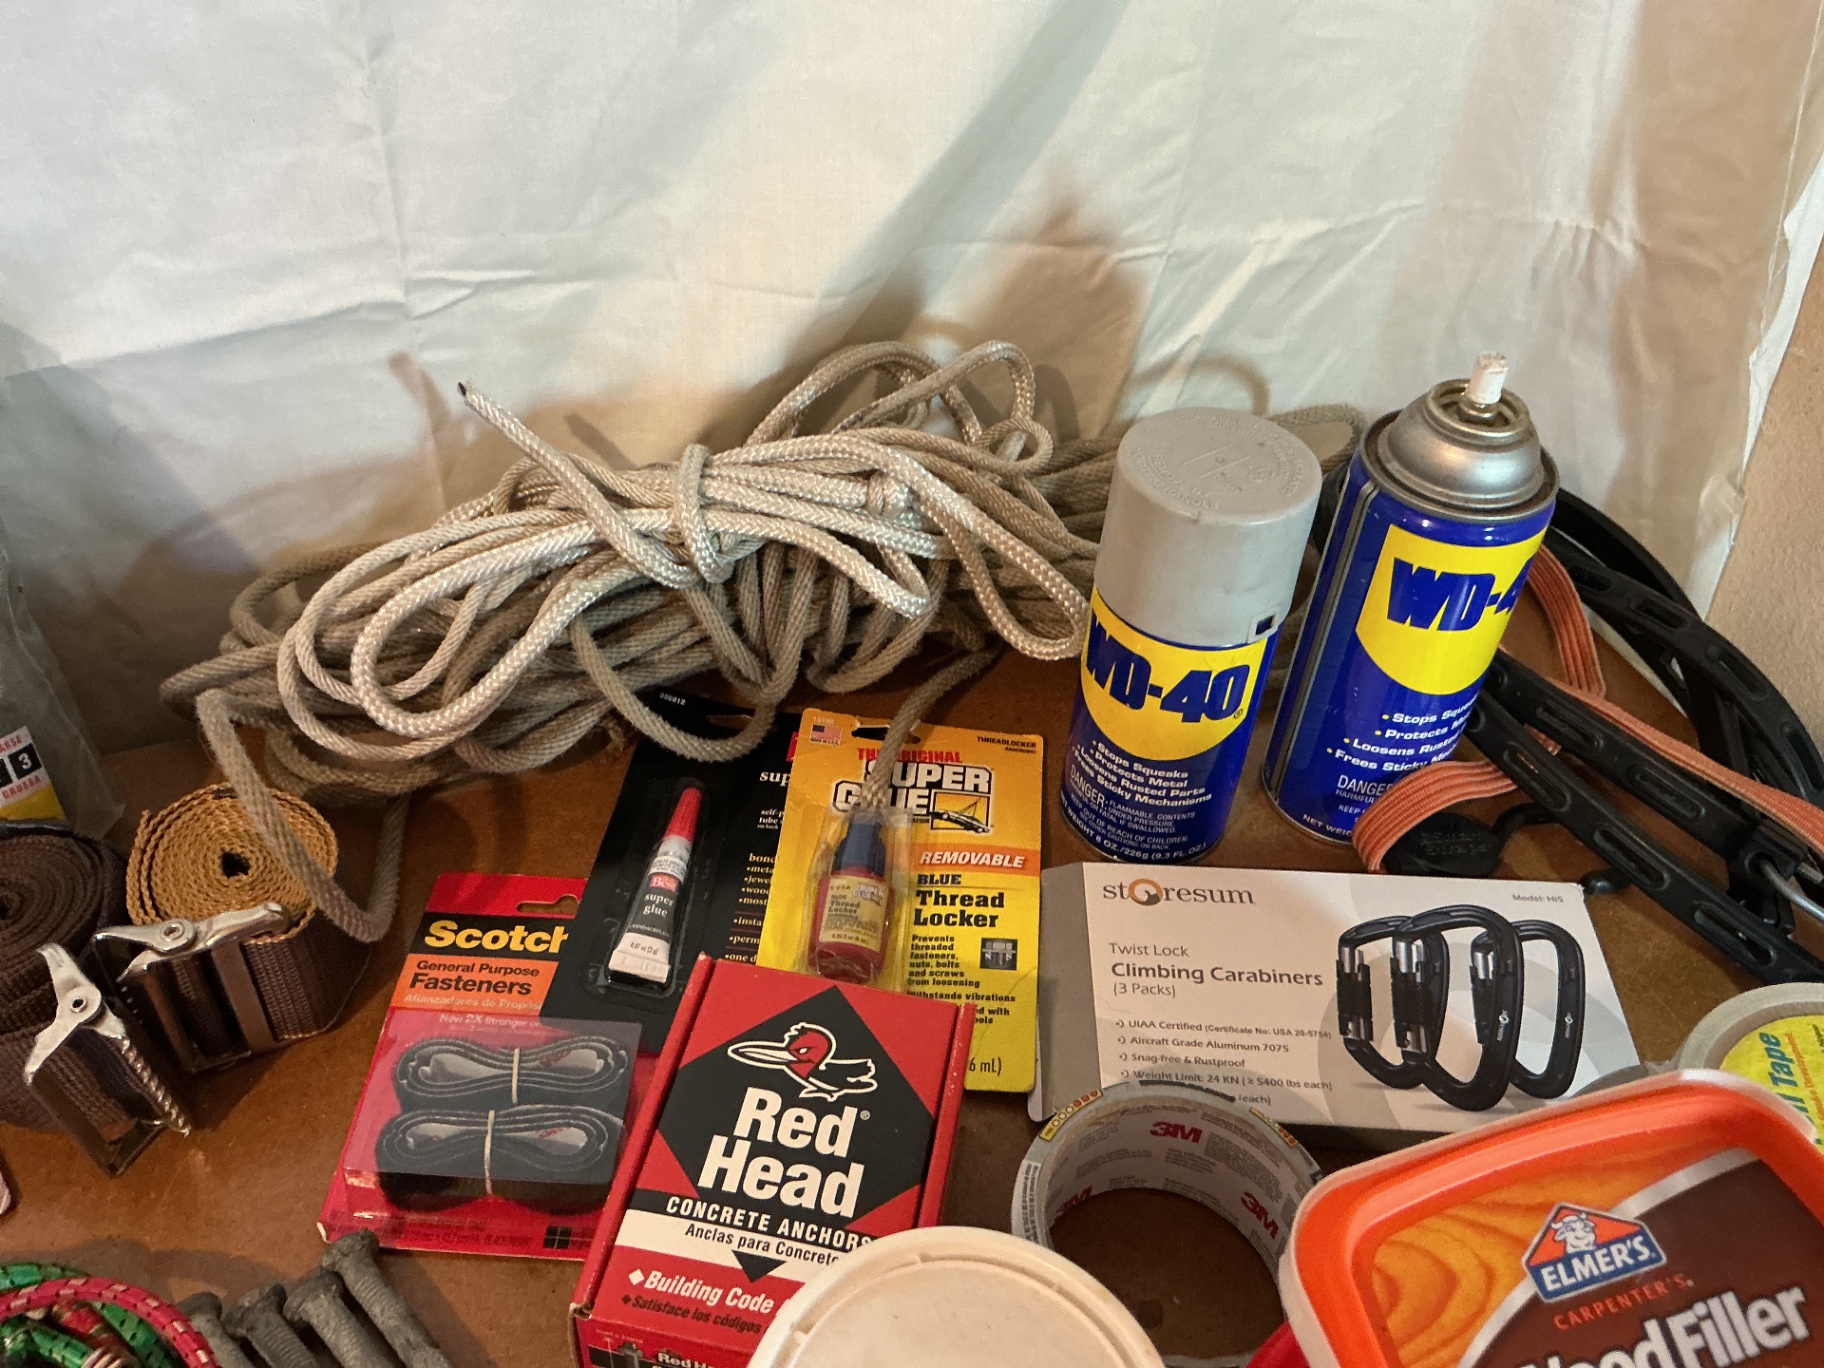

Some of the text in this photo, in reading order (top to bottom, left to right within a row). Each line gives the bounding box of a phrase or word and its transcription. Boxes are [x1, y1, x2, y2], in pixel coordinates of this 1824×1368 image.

[1086, 607, 1250, 723] WD-40
[1392, 713, 1438, 726] Stops
[1384, 726, 1448, 740] Protects
[977, 736, 1036, 748] THREADLOCKER
[1352, 738, 1415, 756] Loosens
[18, 753, 32, 770] 3
[1098, 742, 1188, 778] Stops Squeaks
[1335, 749, 1377, 770] Frees
[1081, 747, 1205, 797] Loosens Rusted Parts
[1095, 751, 1188, 788] Protects Metal
[1097, 775, 1131, 800] Sticky
[1135, 793, 1212, 807] Mechanisms
[759, 816, 778, 825] tube
[1302, 814, 1324, 828] NET
[920, 851, 1025, 868] REMOVABLE
[917, 873, 962, 885] BLUE
[644, 893, 674, 906] super
[915, 890, 1005, 908] Thread
[1512, 894, 1545, 902] Model:
[643, 904, 668, 917] glue
[913, 908, 999, 928] Locker
[910, 943, 954, 951] threaded
[911, 934, 955, 943] Prevents
[1109, 942, 1189, 957] Twist Lock
[417, 960, 540, 977] General Purpose
[908, 969, 927, 977] and
[935, 960, 960, 969] bolts
[1111, 962, 1323, 986] Climbing Carabiners
[410, 973, 531, 995] Fasteners
[906, 978, 980, 988] from loosening
[1113, 982, 1176, 998] (3 Packs)
[482, 996, 496, 1008] de
[965, 992, 1016, 1002] vibrations
[464, 1014, 483, 1024] 2X
[988, 1007, 1010, 1016] with
[1129, 1020, 1157, 1028] UIAA
[1159, 1021, 1202, 1031] Certified
[1205, 1024, 1252, 1034] (Certificate
[1273, 1028, 1293, 1036] USA
[1130, 1036, 1289, 1052] Aircraft Grade Aluminum 7075
[980, 1057, 1002, 1077] mL)
[1132, 1053, 1245, 1068] Snag-free & Rustproof
[1758, 1032, 1799, 1087] Tape
[1133, 1070, 1173, 1080] Weight
[1207, 1074, 1220, 1083] 24
[1222, 1075, 1239, 1085] KN
[1256, 1077, 1284, 1087] 5400
[1286, 1078, 1301, 1088] lbs
[1303, 1080, 1332, 1091] each)
[733, 1086, 858, 1157] Red
[1149, 1121, 1202, 1144] 3M
[697, 1134, 864, 1218] Head
[666, 1196, 771, 1232] CONCRETE
[1240, 1191, 1279, 1240] 3M
[685, 1223, 734, 1246] Anclas
[737, 1234, 771, 1256] para
[1540, 1236, 1652, 1293] ELMER'S
[644, 1270, 775, 1314] Building Code
[631, 1294, 691, 1319] Satisface
[692, 1307, 712, 1323] los
[1553, 1272, 1688, 1332] CARPENTER'S
